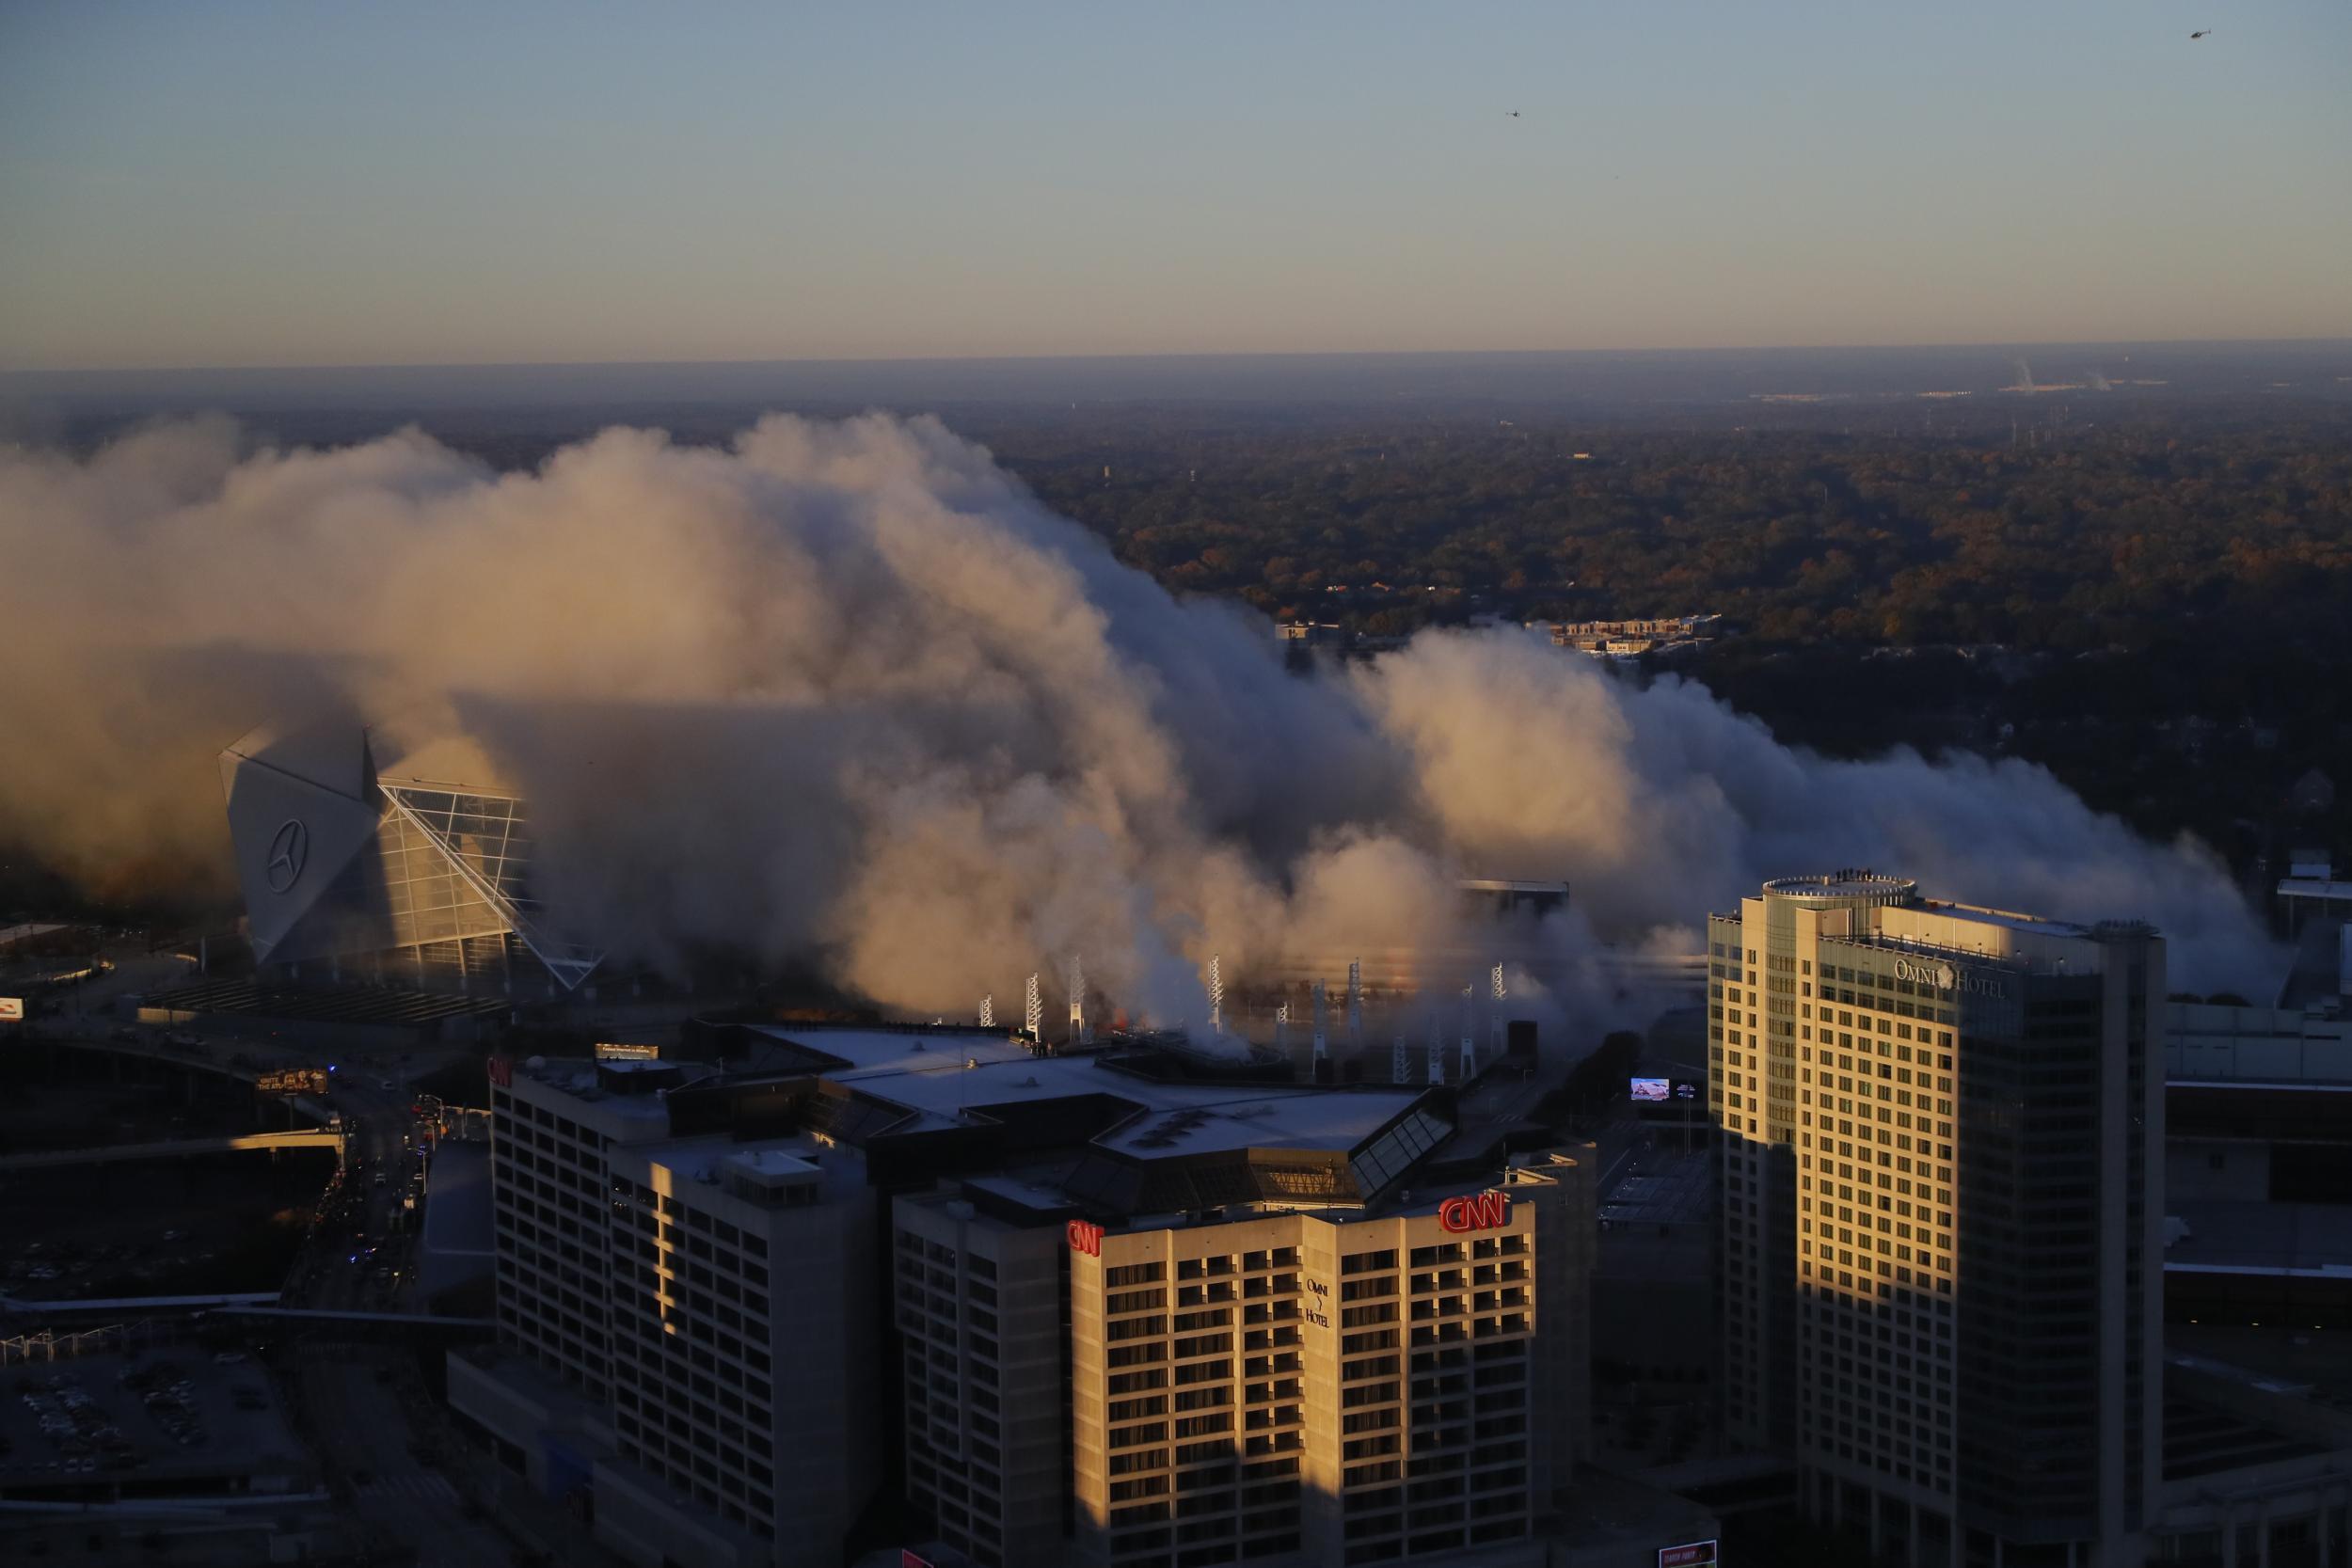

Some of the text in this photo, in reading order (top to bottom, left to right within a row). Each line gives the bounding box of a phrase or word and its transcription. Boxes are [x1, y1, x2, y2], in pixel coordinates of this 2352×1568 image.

[1894, 958, 2006, 999] OMNI HOTEL
[486, 1054, 512, 1086] CNN
[1438, 1191, 1506, 1233] CNN
[1066, 1219, 1104, 1257] CNN
[1307, 1278, 1328, 1297] OMNI
[1306, 1308, 1329, 1328] HOTEL
